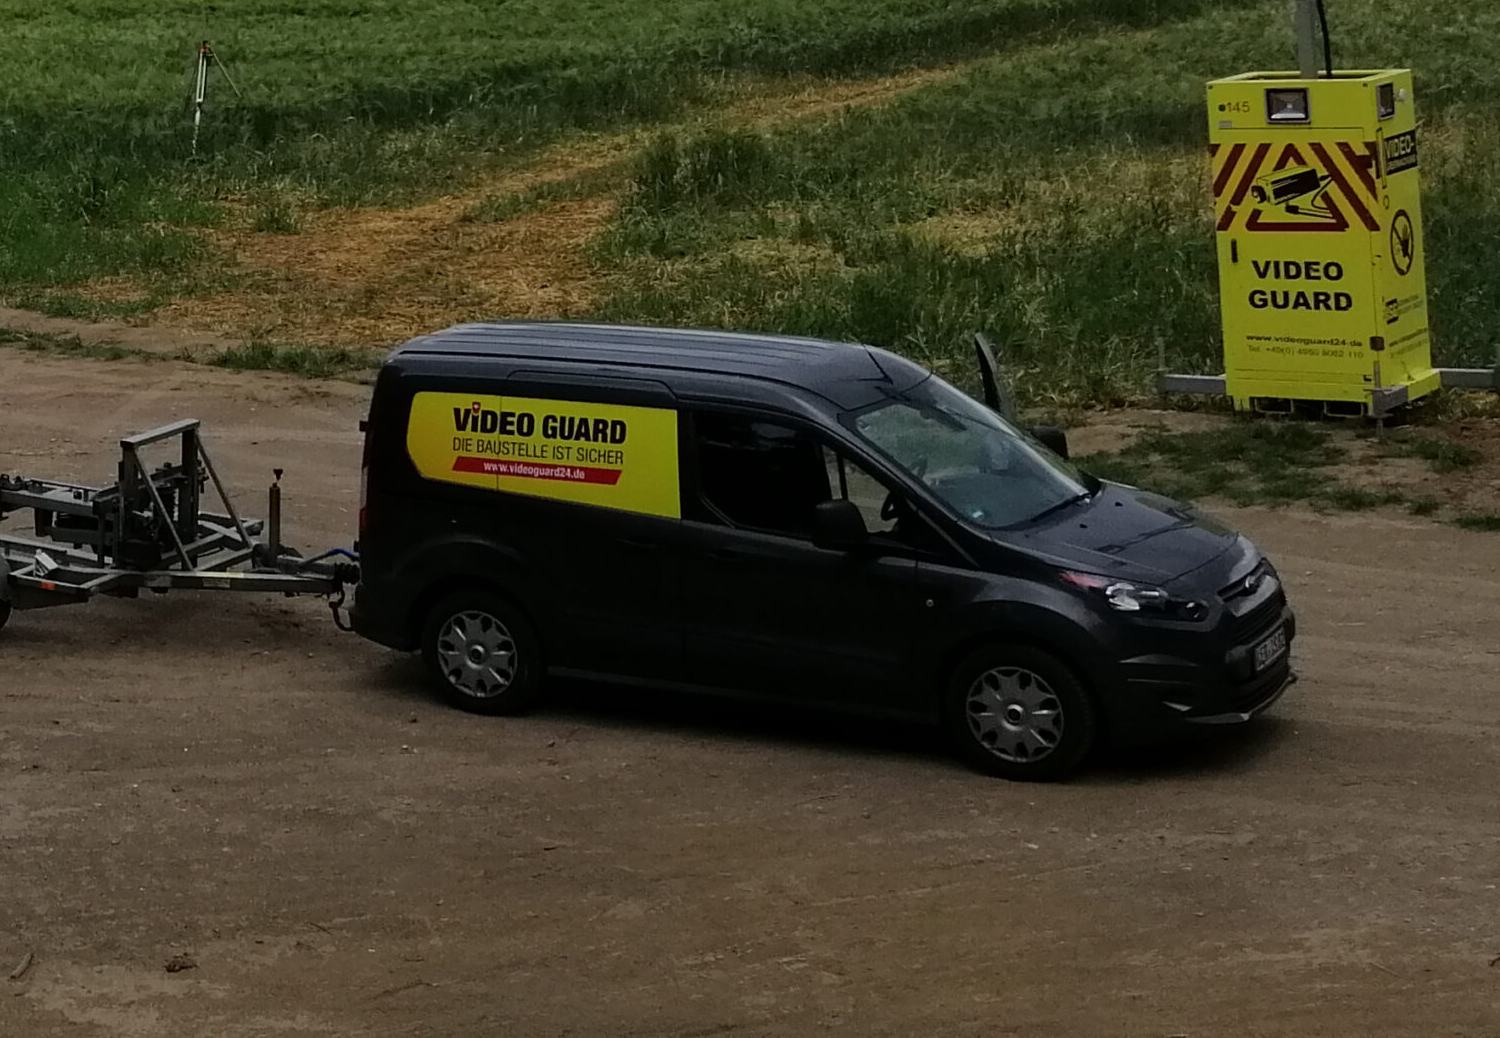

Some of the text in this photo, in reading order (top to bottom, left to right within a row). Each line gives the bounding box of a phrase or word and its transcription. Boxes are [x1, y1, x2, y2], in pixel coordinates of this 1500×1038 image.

[1226, 101, 1250, 113] 145
[1252, 260, 1344, 281] VIDEO
[1248, 289, 1353, 311] GUARD
[1246, 334, 1363, 347] www.videoguard24.de
[542, 414, 627, 444] GUARD
[452, 437, 624, 465] DIE BAUSTELLE IST SICHER
[483, 461, 585, 480] www.videoguard24.de
